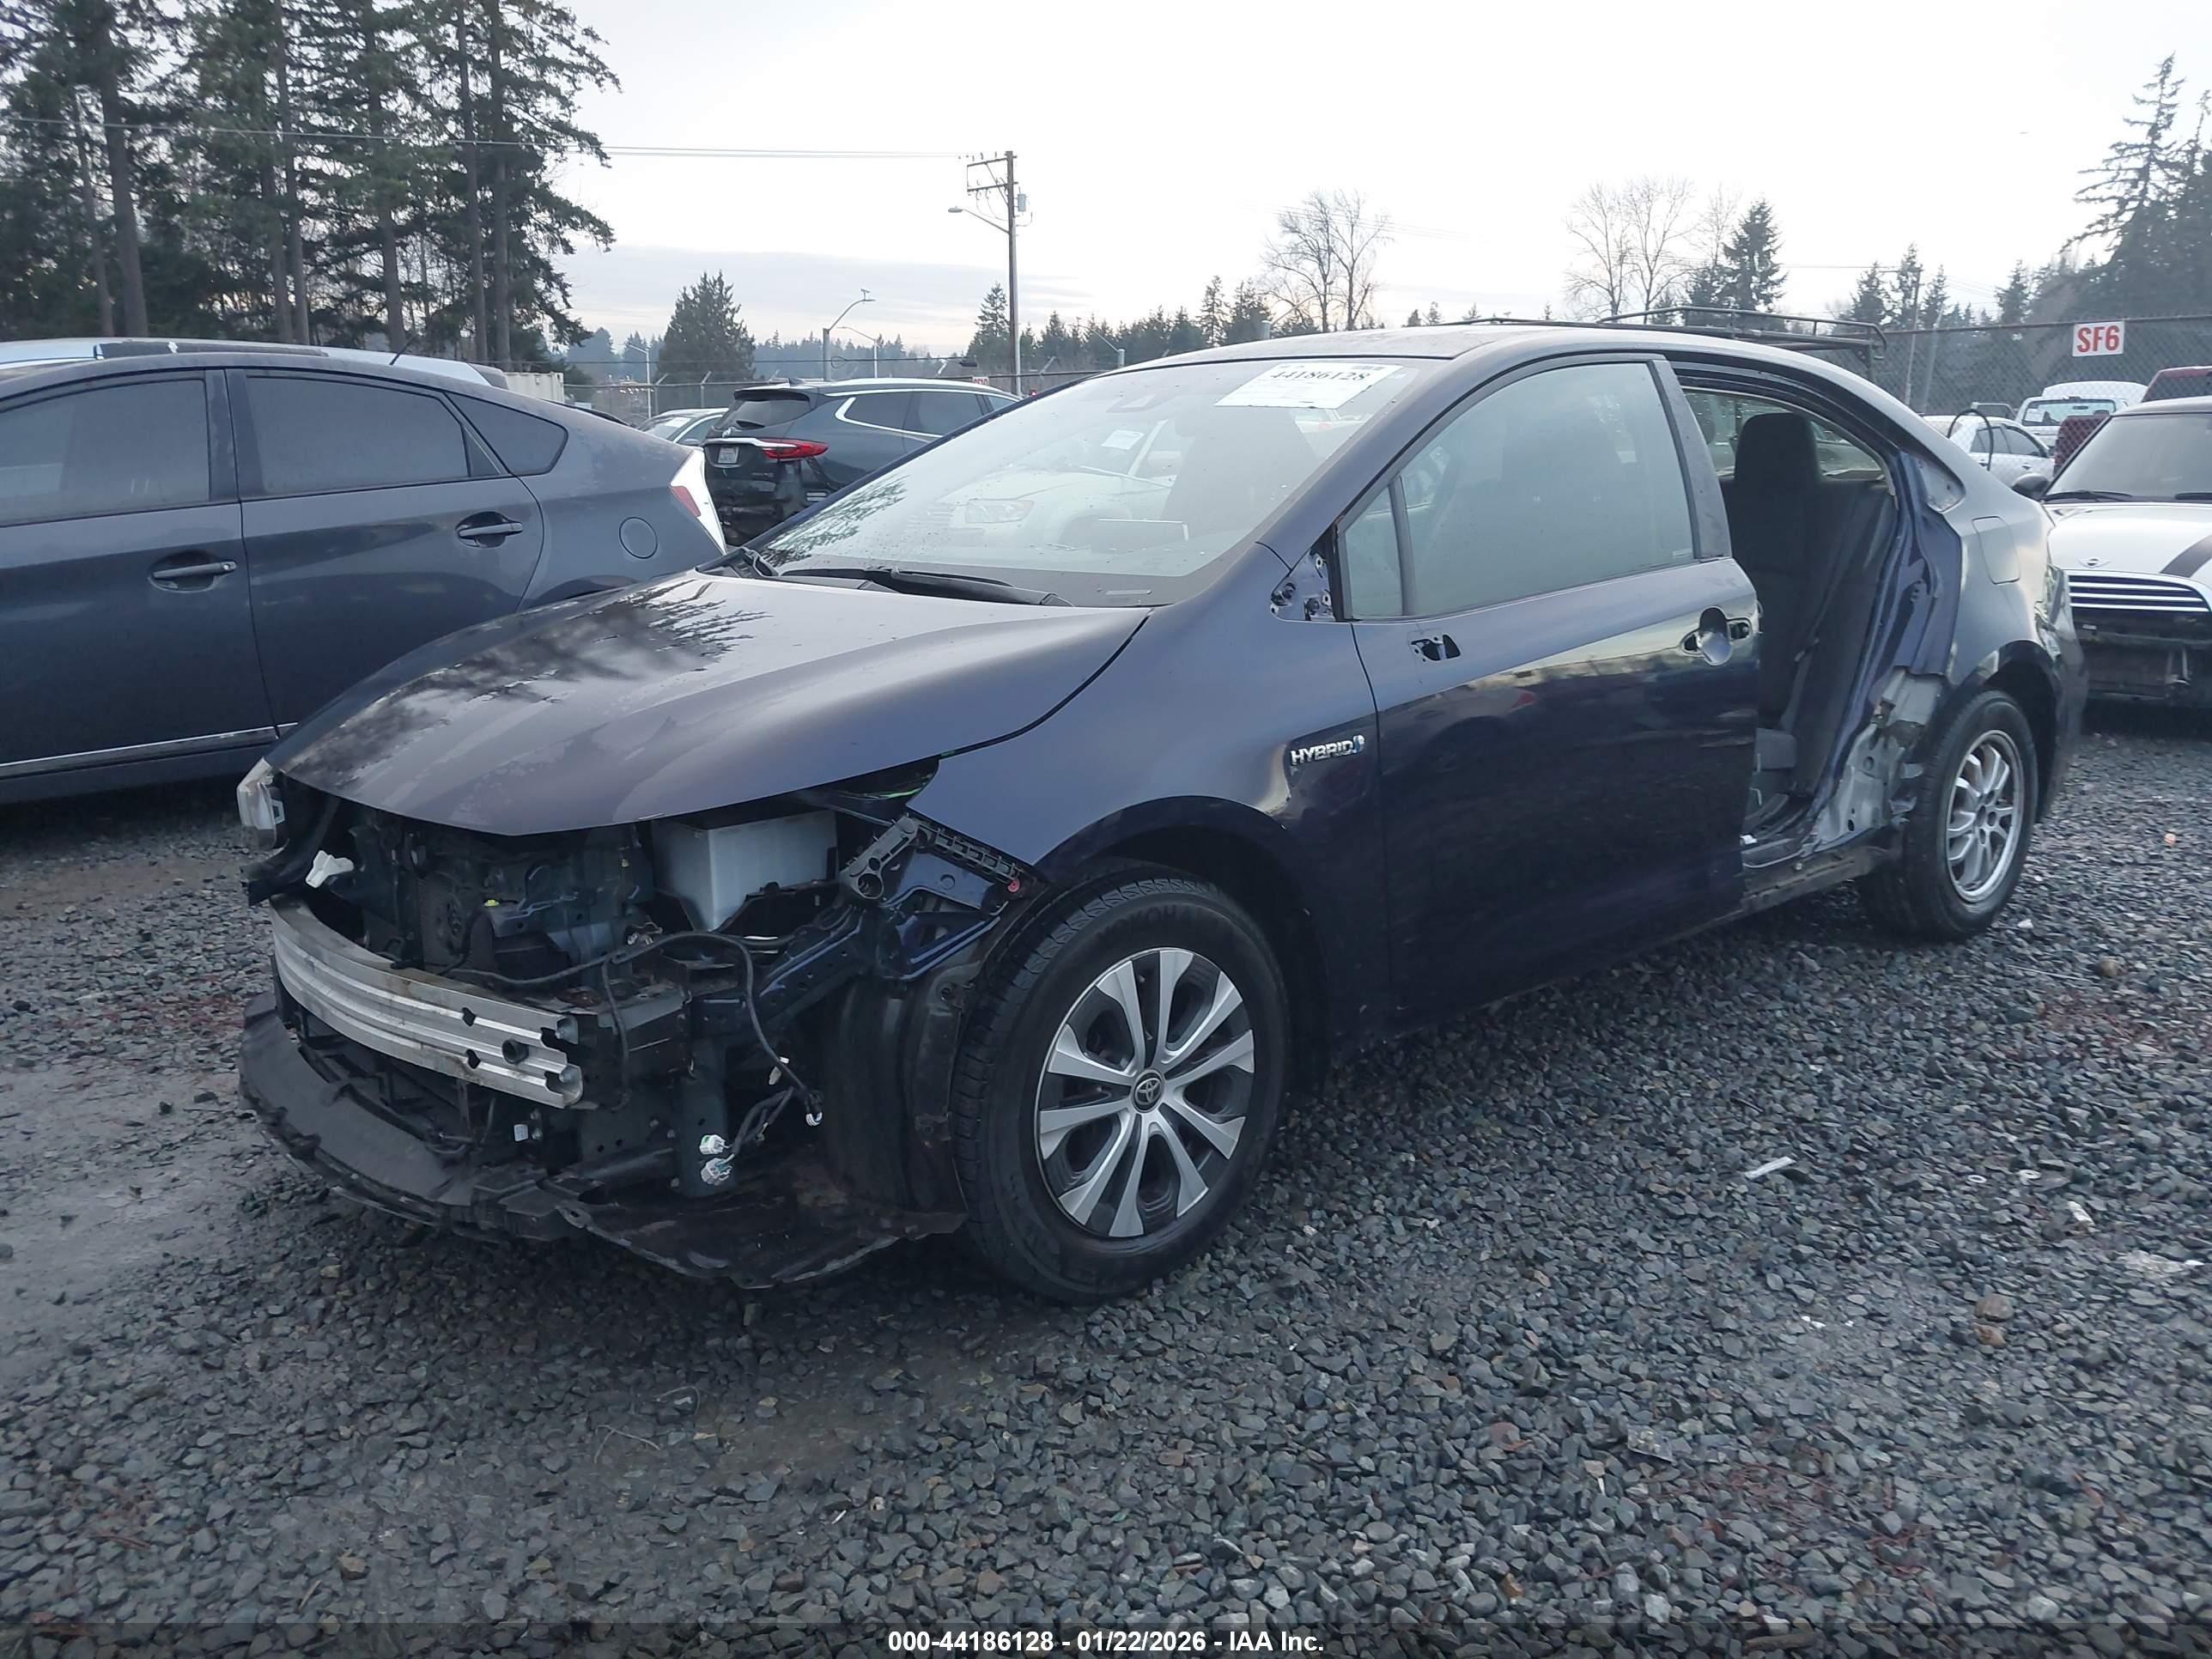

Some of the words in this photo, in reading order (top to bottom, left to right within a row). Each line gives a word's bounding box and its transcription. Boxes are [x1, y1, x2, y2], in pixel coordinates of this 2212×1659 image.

[2076, 325, 2119, 352] SF6
[1271, 370, 1370, 381] 44186128
[1291, 740, 1353, 764] HYBRID
